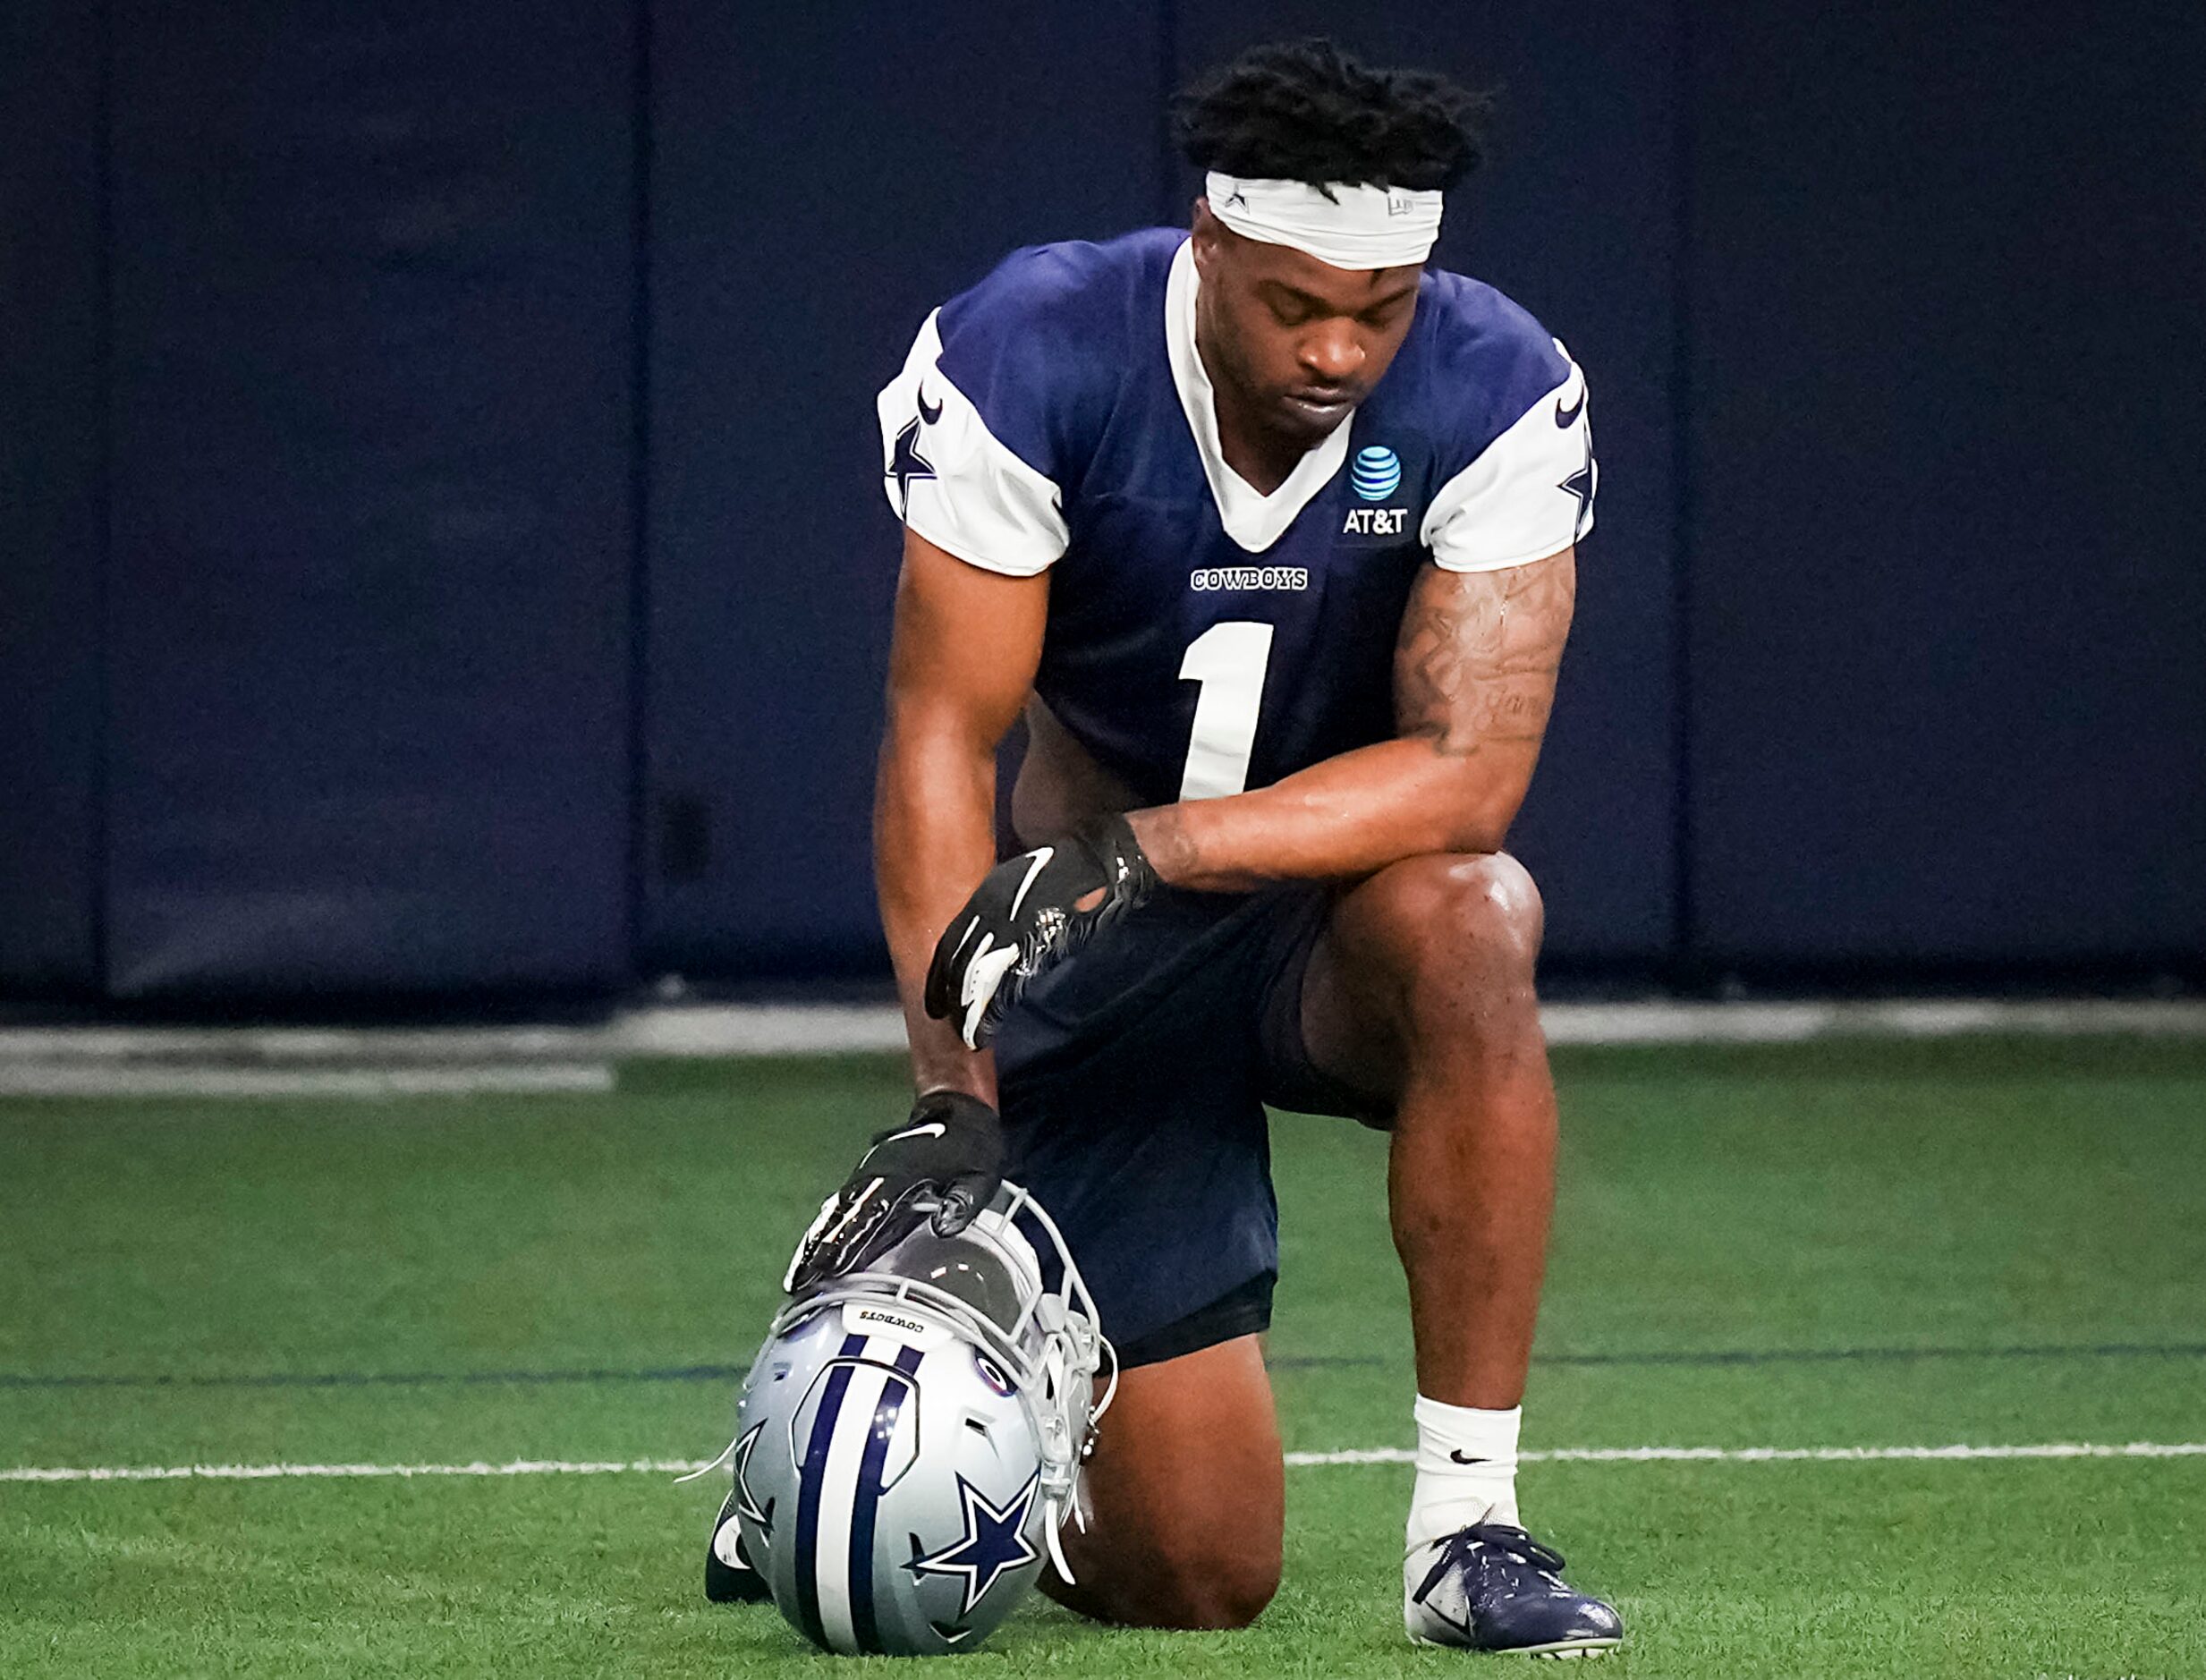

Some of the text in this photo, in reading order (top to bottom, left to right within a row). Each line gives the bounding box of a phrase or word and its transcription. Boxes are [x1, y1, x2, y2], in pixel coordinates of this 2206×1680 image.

[1344, 509, 1407, 534] AT&T
[1191, 566, 1308, 590] COWBOYS
[1178, 621, 1274, 802] 1
[860, 1311, 924, 1333] COWBOYS
